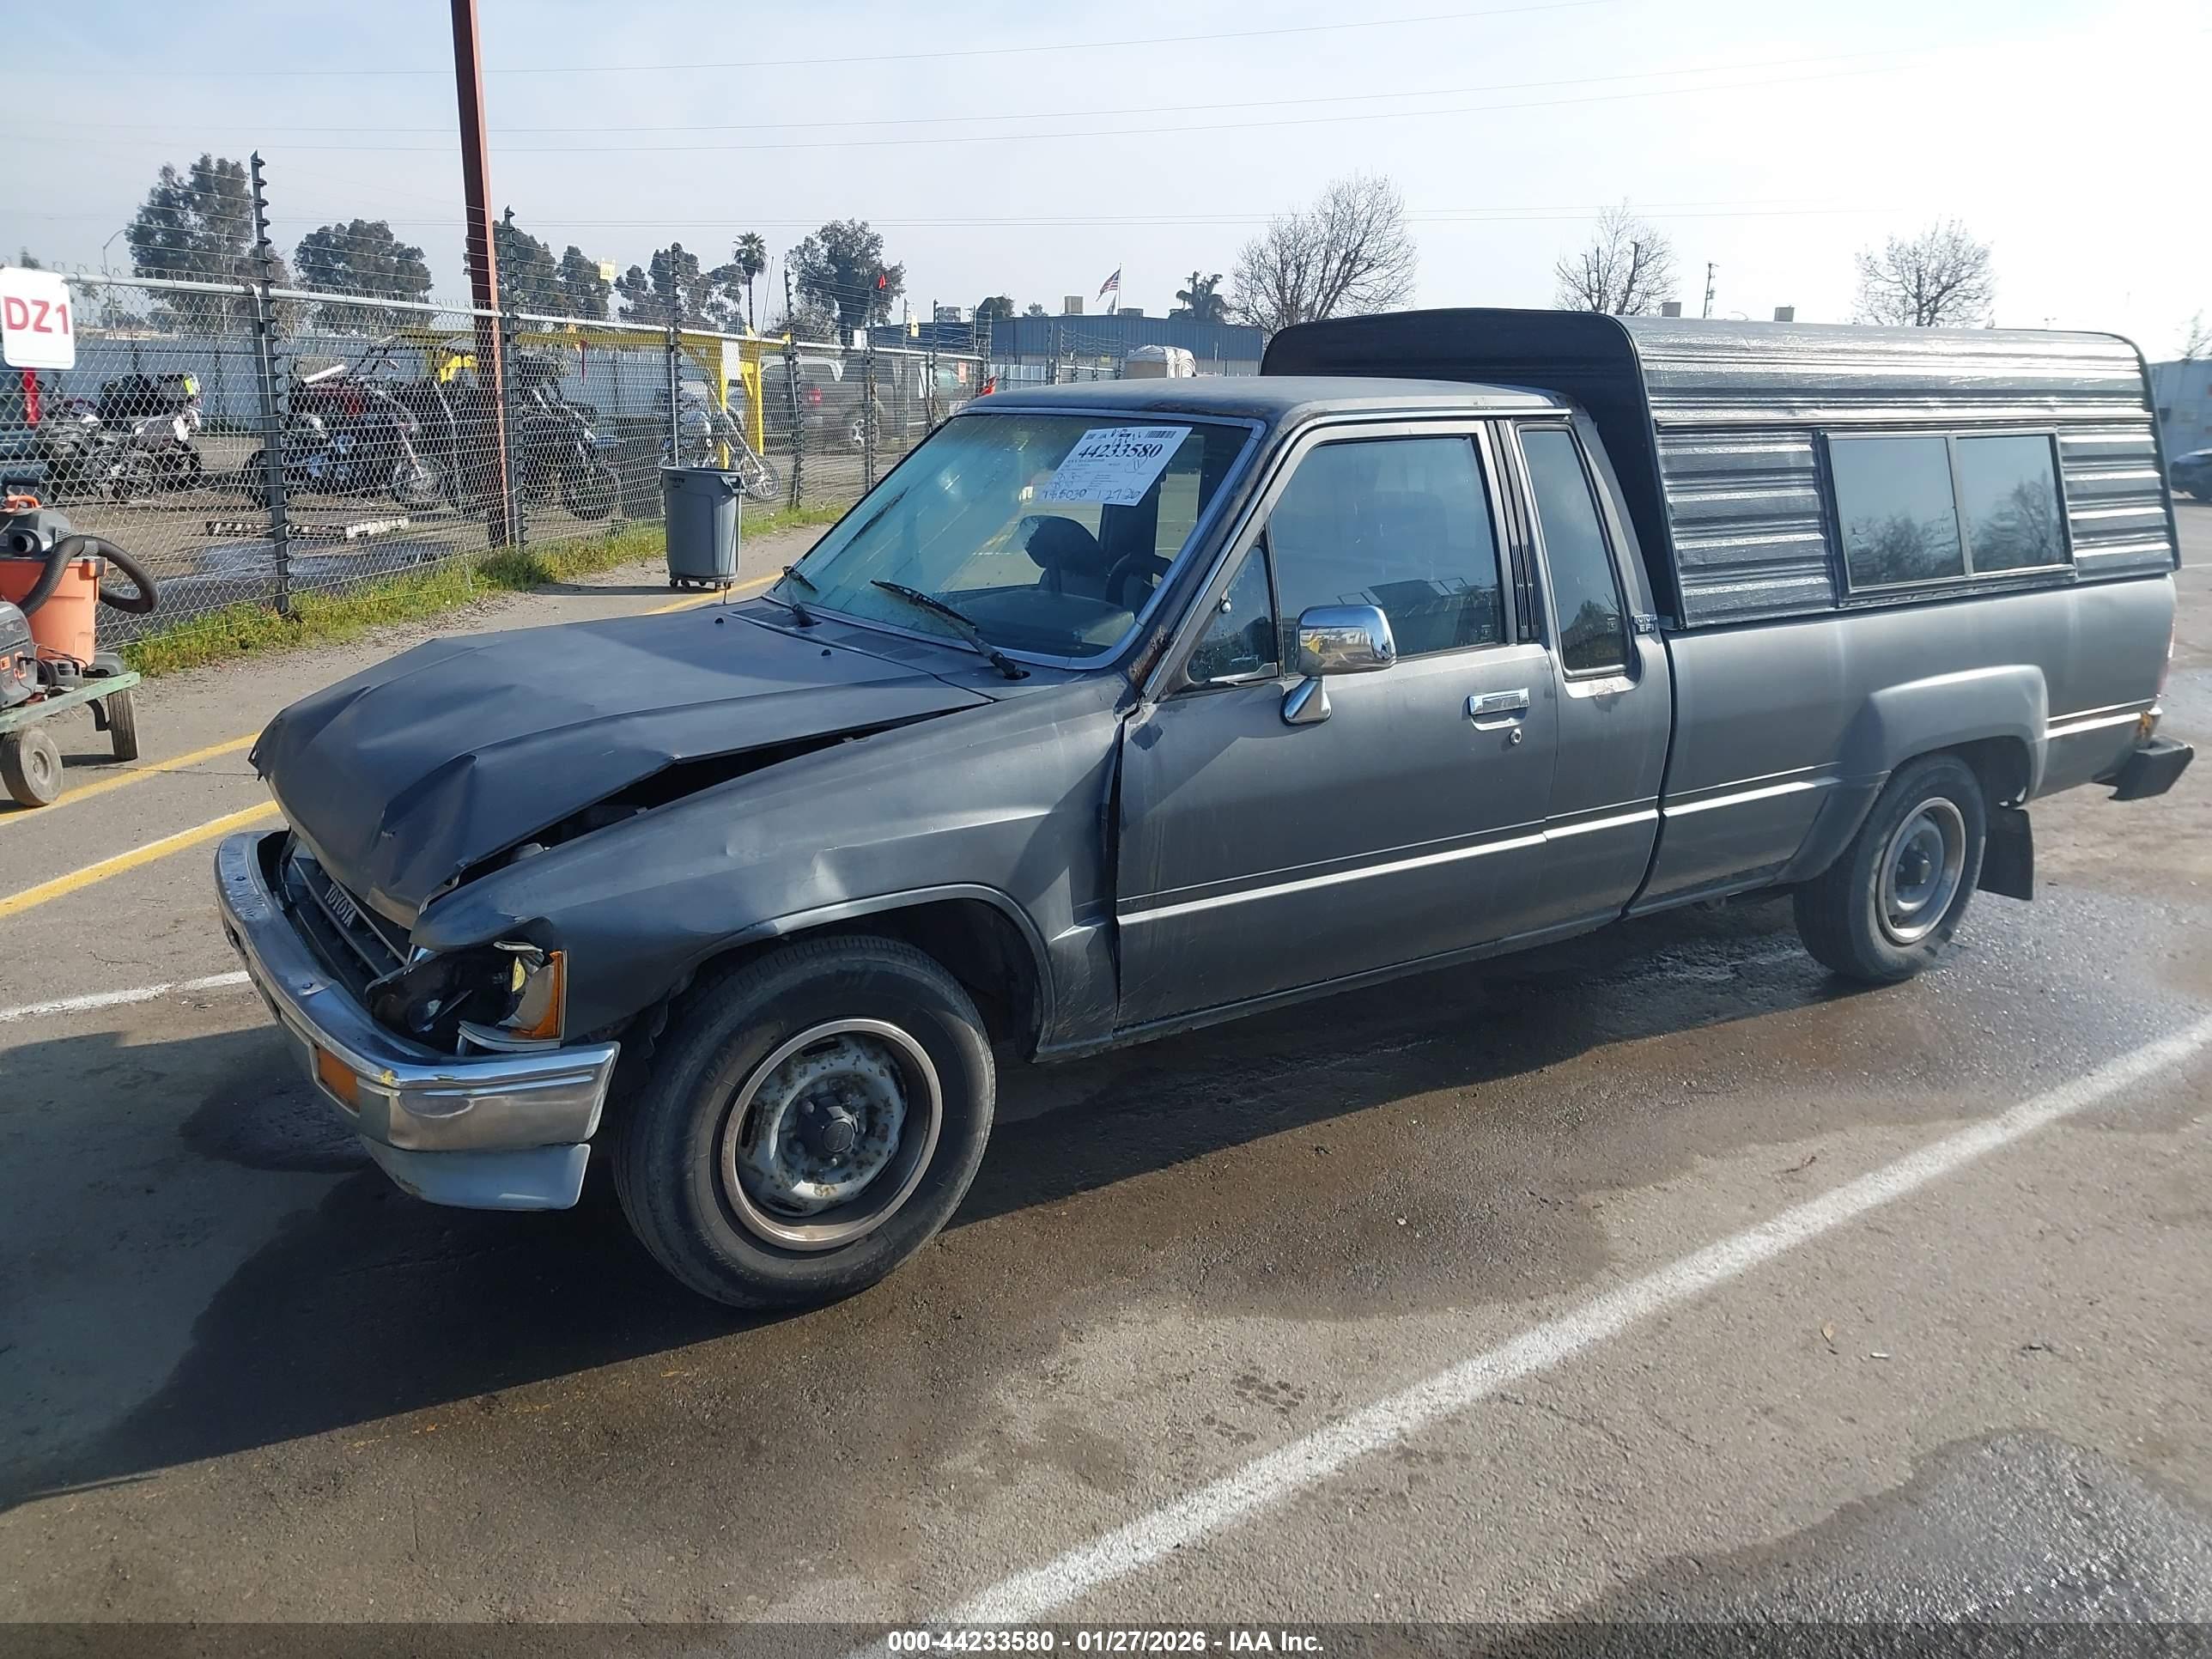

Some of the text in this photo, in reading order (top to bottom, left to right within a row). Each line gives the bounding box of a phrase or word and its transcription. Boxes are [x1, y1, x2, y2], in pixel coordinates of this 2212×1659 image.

[3, 296, 69, 335] DZ1
[1079, 443, 1164, 459] 44233580
[1639, 623, 1655, 632] EFI
[325, 883, 357, 928] TOYOTA
